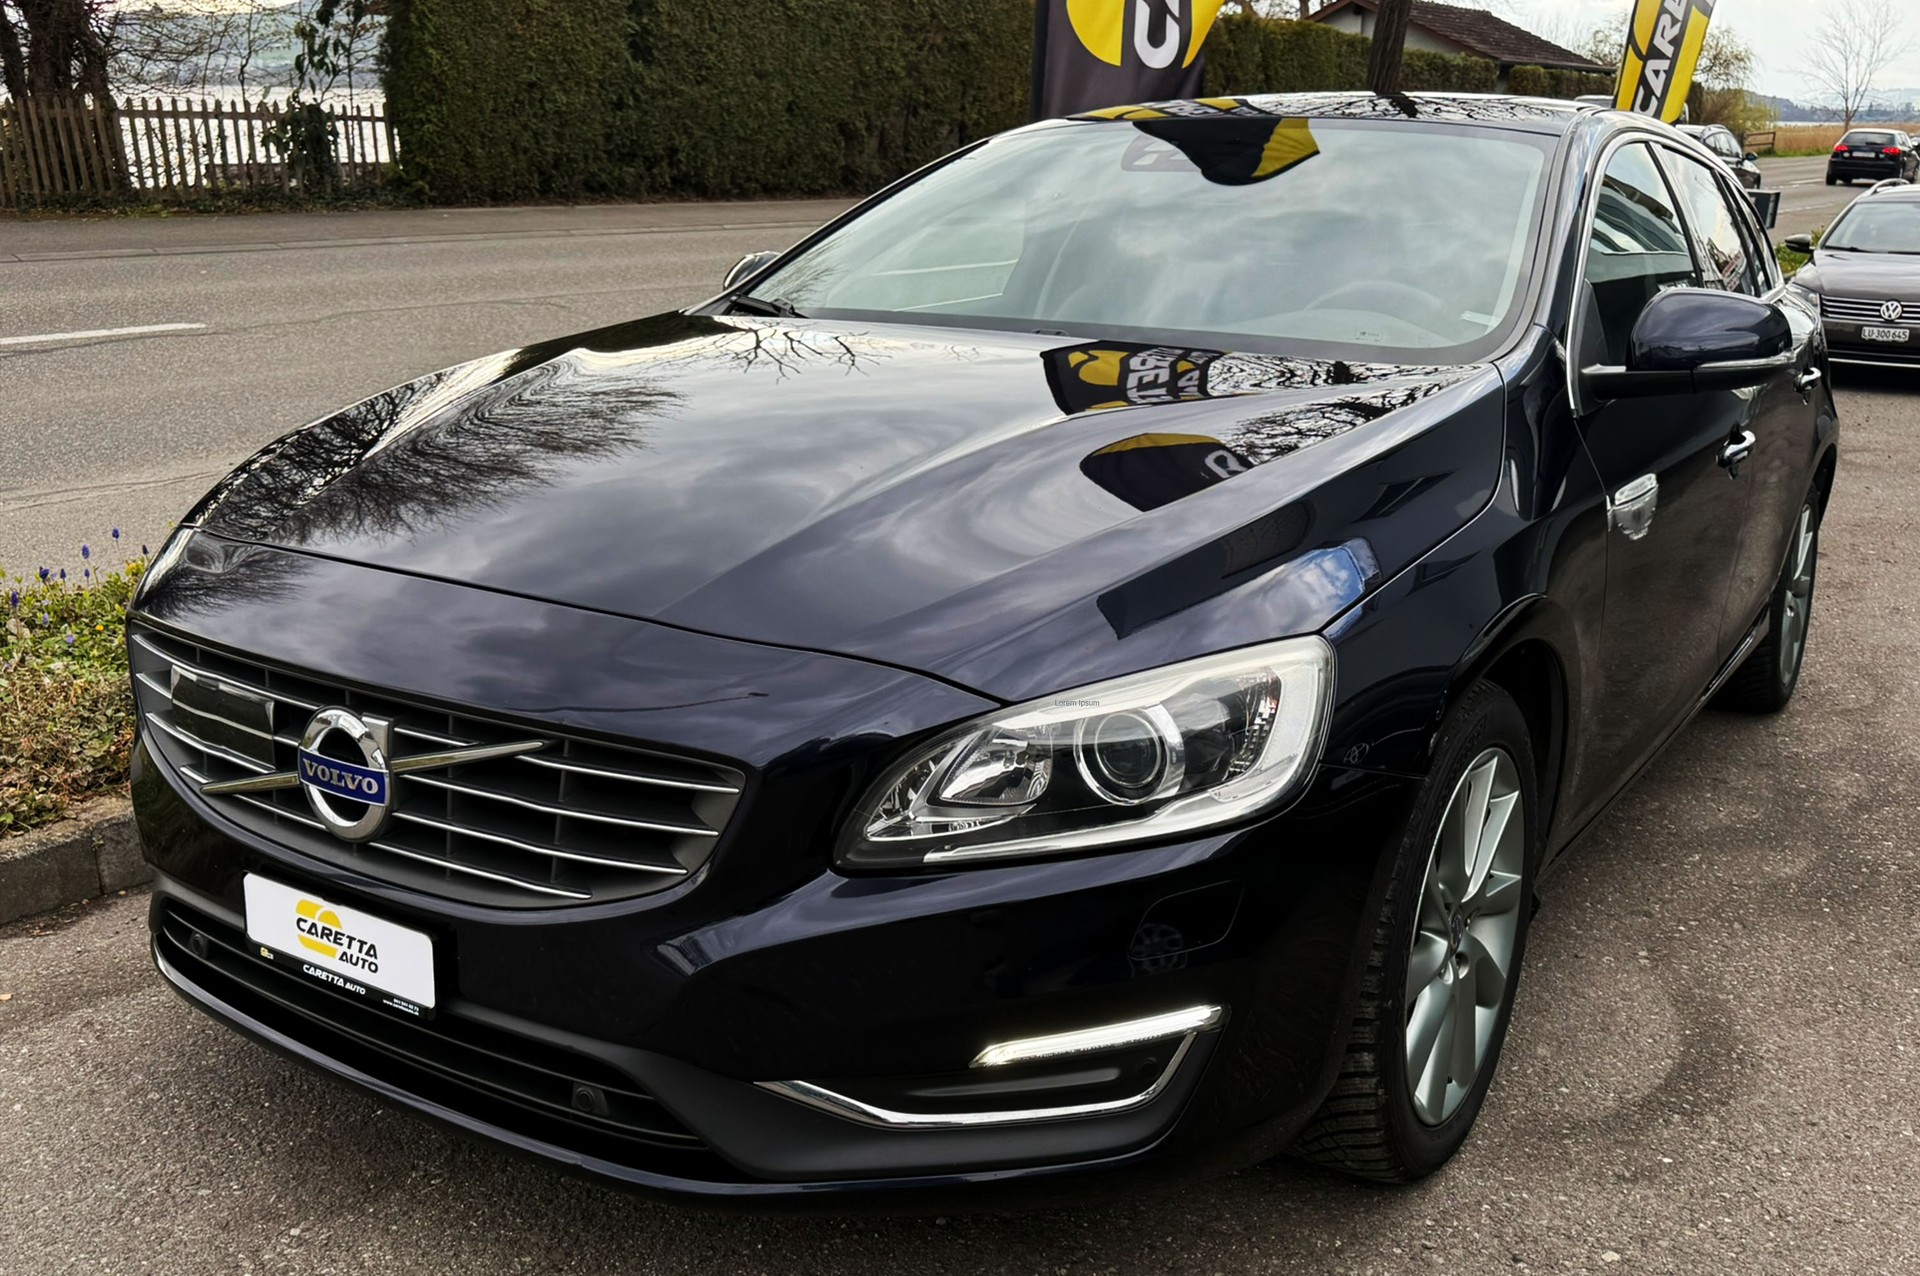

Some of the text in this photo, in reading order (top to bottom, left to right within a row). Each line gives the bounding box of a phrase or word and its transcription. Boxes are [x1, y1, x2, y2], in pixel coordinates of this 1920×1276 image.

[302, 758, 379, 795] VOLVO
[295, 917, 379, 960] CARETTA
[302, 964, 366, 995] CARETTA AUTO
[338, 951, 379, 974] AUTO
